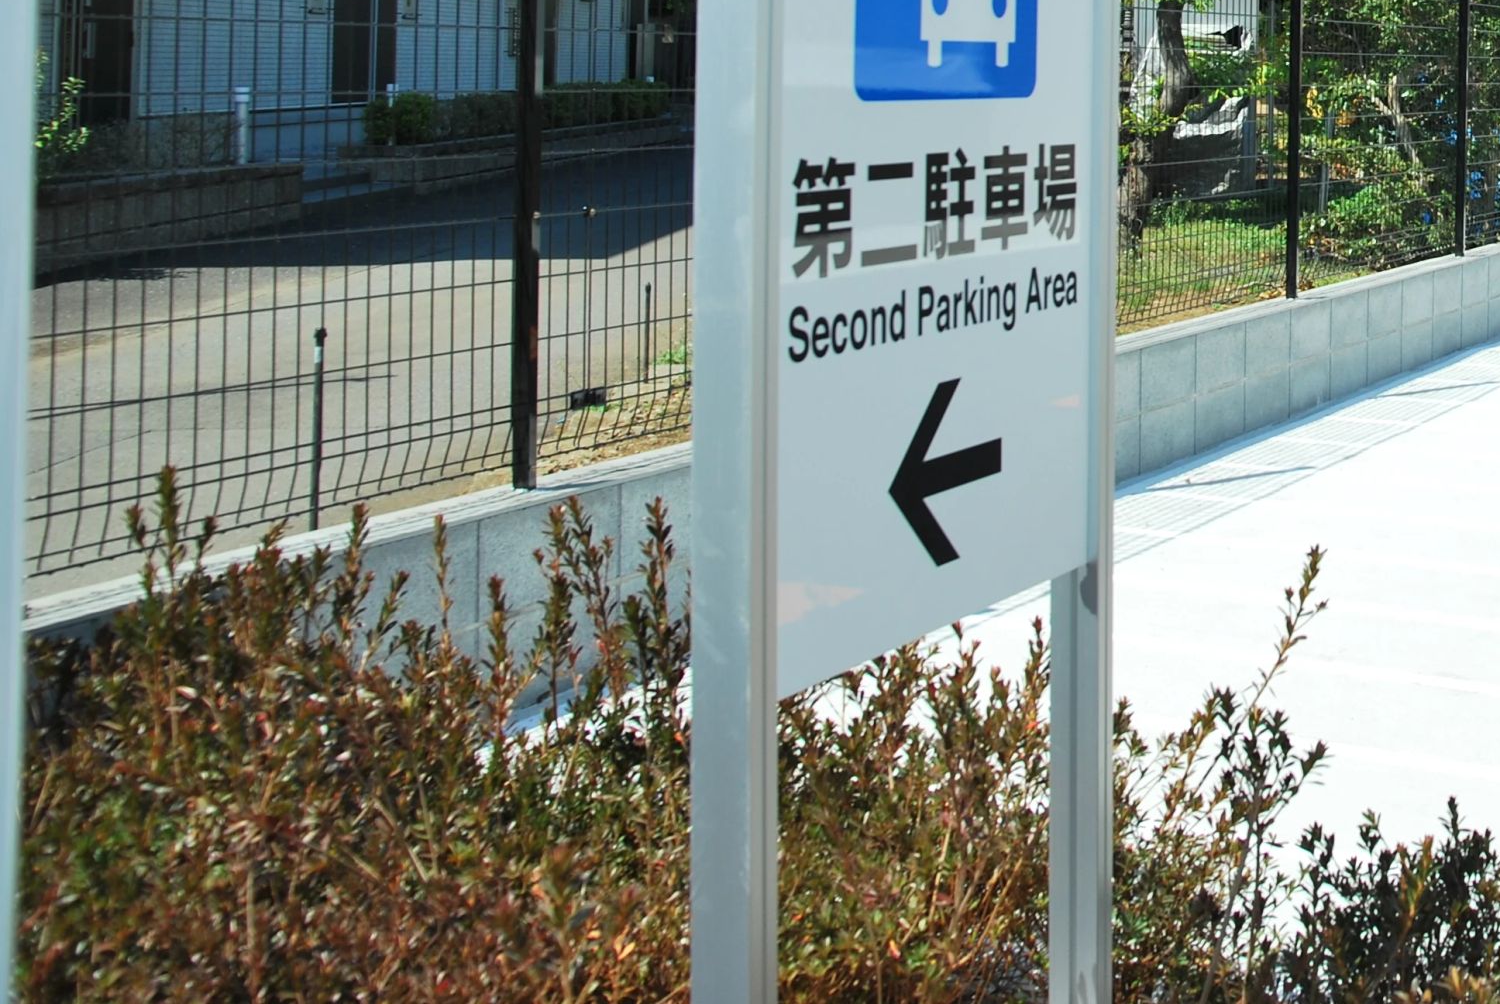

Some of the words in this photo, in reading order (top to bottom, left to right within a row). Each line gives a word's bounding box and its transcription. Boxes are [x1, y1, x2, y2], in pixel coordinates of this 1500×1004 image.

[792, 143, 1077, 278] 第二駐車場
[788, 289, 906, 363] Second
[918, 278, 1016, 331] Parking
[1025, 266, 1077, 313] Area
